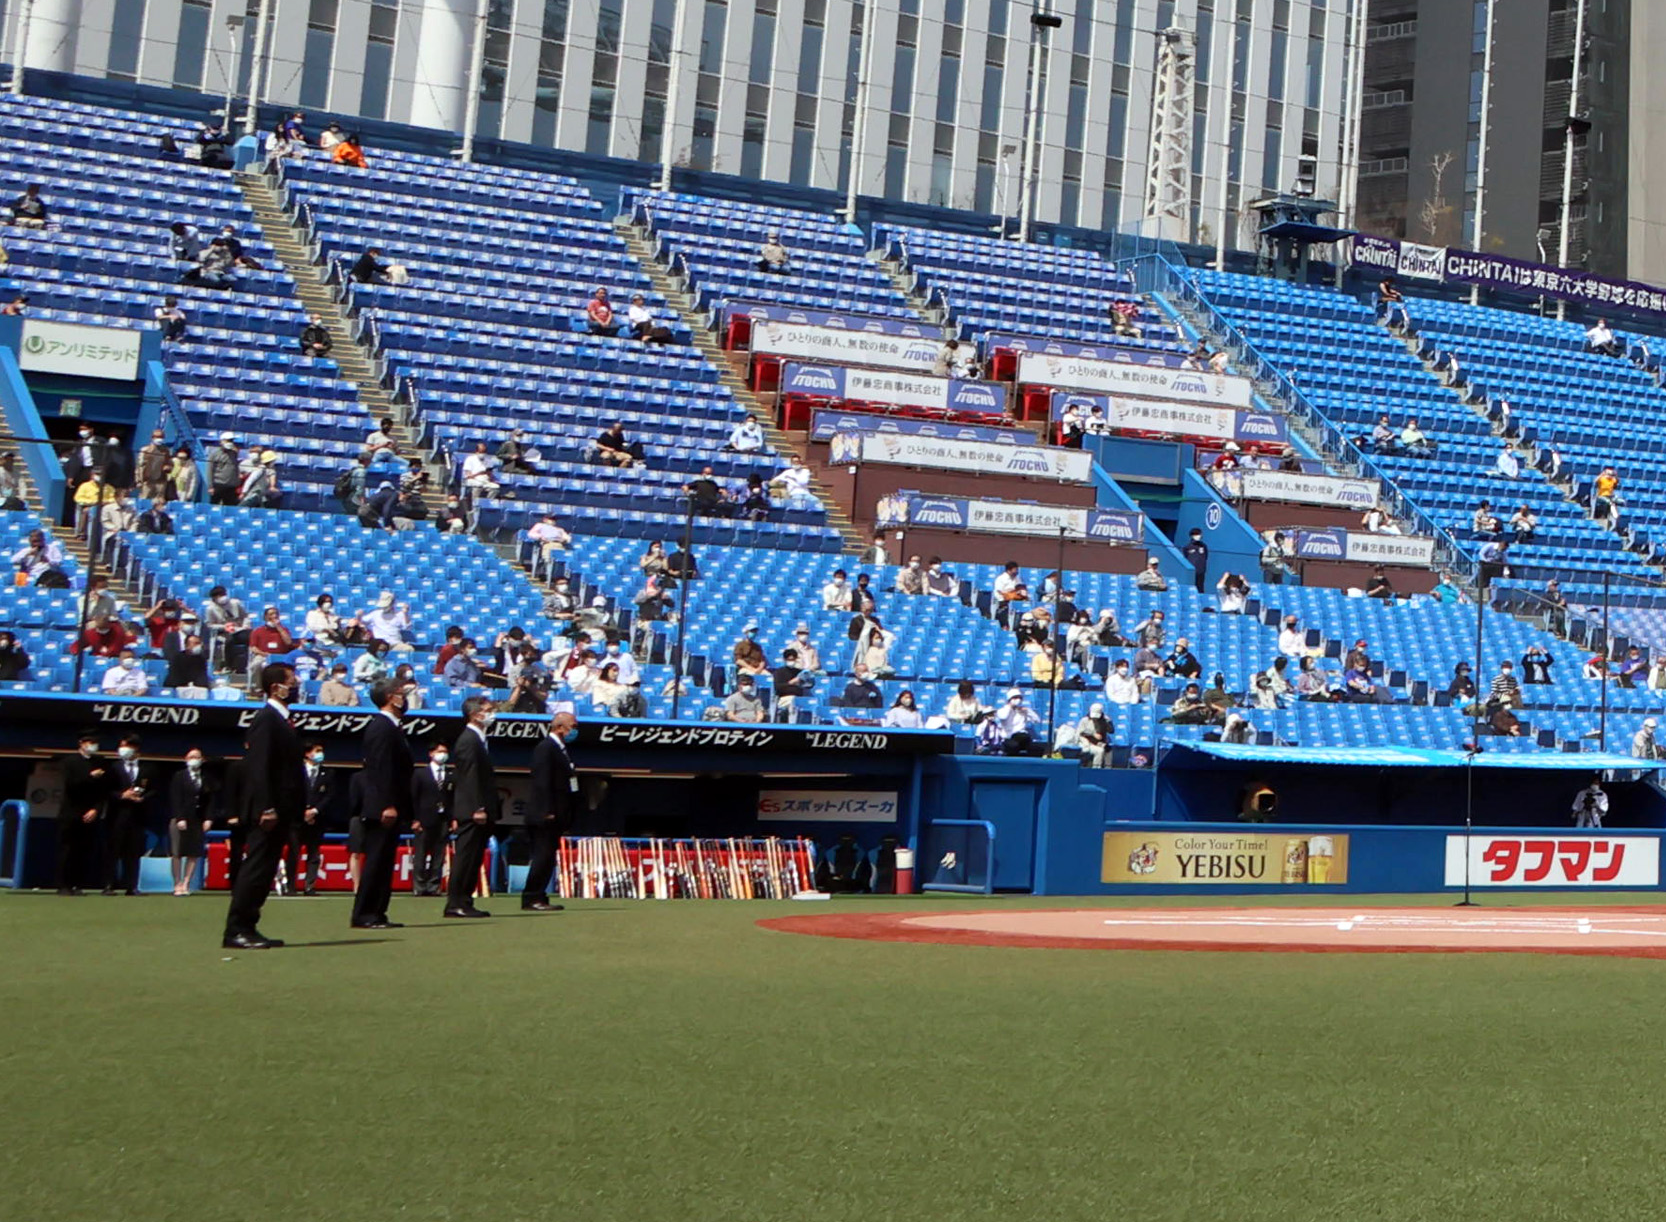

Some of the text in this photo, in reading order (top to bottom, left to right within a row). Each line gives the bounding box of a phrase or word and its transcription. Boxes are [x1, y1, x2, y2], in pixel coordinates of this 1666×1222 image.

[46, 340, 138, 363] アンリミテッド
[787, 332, 899, 355] ひとりの商人、無数の使命
[791, 374, 837, 390] ITOCHU
[1068, 365, 1167, 387] ひとりの商人、無数の使命
[852, 377, 942, 397] 伊藤忠商事株式会社
[1171, 380, 1207, 395] ITOCHU
[954, 391, 996, 407] ITOCHU
[1132, 406, 1212, 426] 伊藤忠商事株式会社
[1241, 421, 1279, 436] ITOCHU
[906, 444, 1004, 464] ひとりの商人、無数の使命
[1007, 458, 1049, 473] ITOCHU
[1249, 479, 1334, 496] ひとりの商人、無数の使命
[1336, 490, 1373, 504] ITOCHU
[914, 510, 961, 525] ITOCHU
[973, 509, 1062, 527] 伊藤忠商事株式会社
[1208, 508, 1219, 523] 10
[1091, 523, 1133, 539] ITOCHU
[1302, 542, 1342, 556] ITOCHU
[1352, 541, 1426, 558] 伊藤忠商事株式会社
[485, 720, 552, 739] LEGEN
[599, 726, 774, 748] ビーレジェンドプロテイン
[782, 798, 895, 815] スポットバズーカ
[1174, 838, 1268, 851] Color Your Time!
[1175, 854, 1267, 879] YEBISU
[1482, 840, 1626, 882] タフマン
